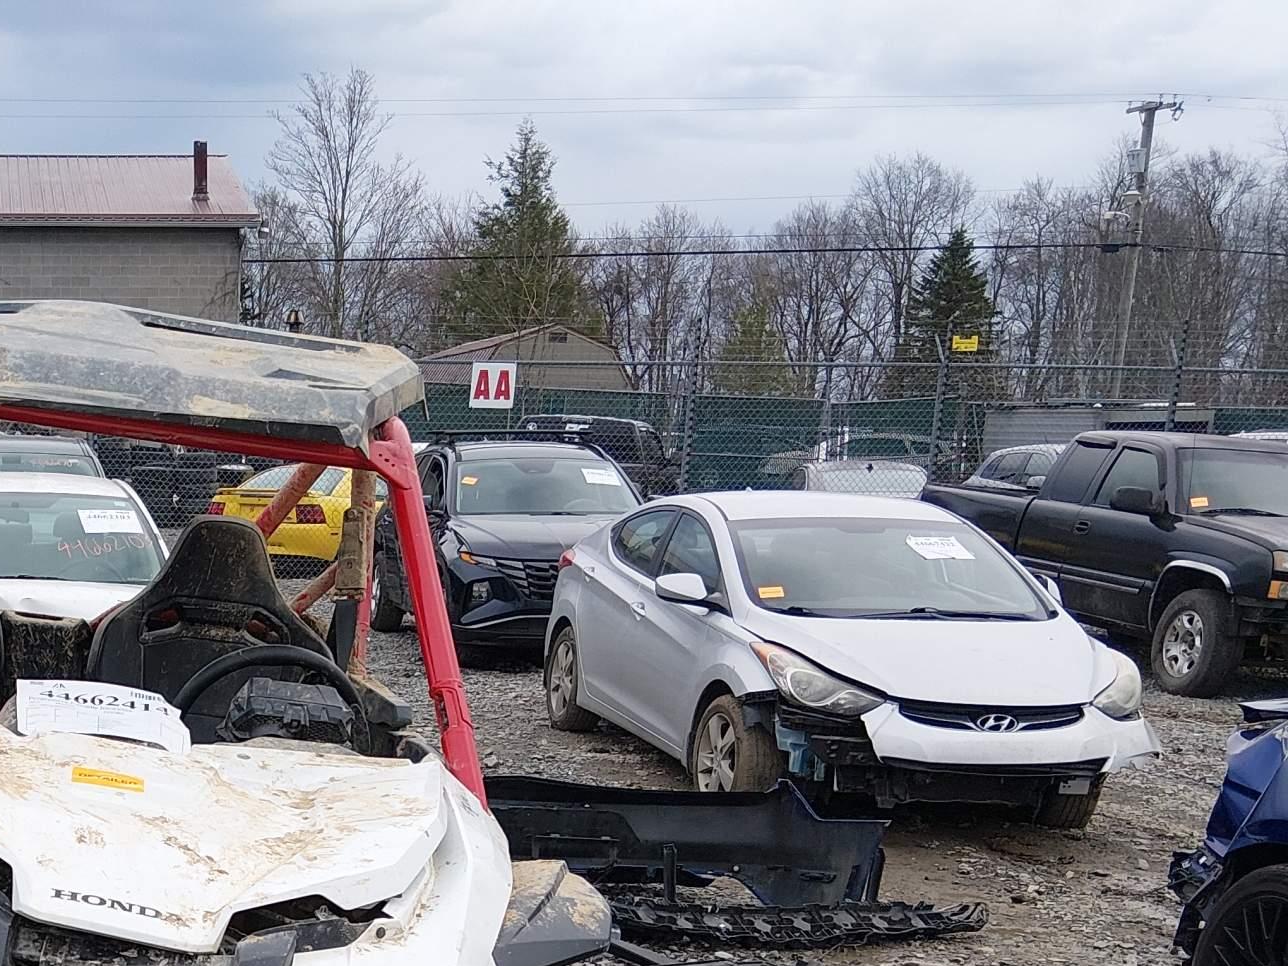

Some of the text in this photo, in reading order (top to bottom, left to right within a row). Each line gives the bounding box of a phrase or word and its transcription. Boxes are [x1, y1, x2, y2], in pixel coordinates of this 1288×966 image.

[473, 369, 510, 400] AA
[39, 689, 170, 716] 44662414
[50, 887, 192, 929] HONDA
